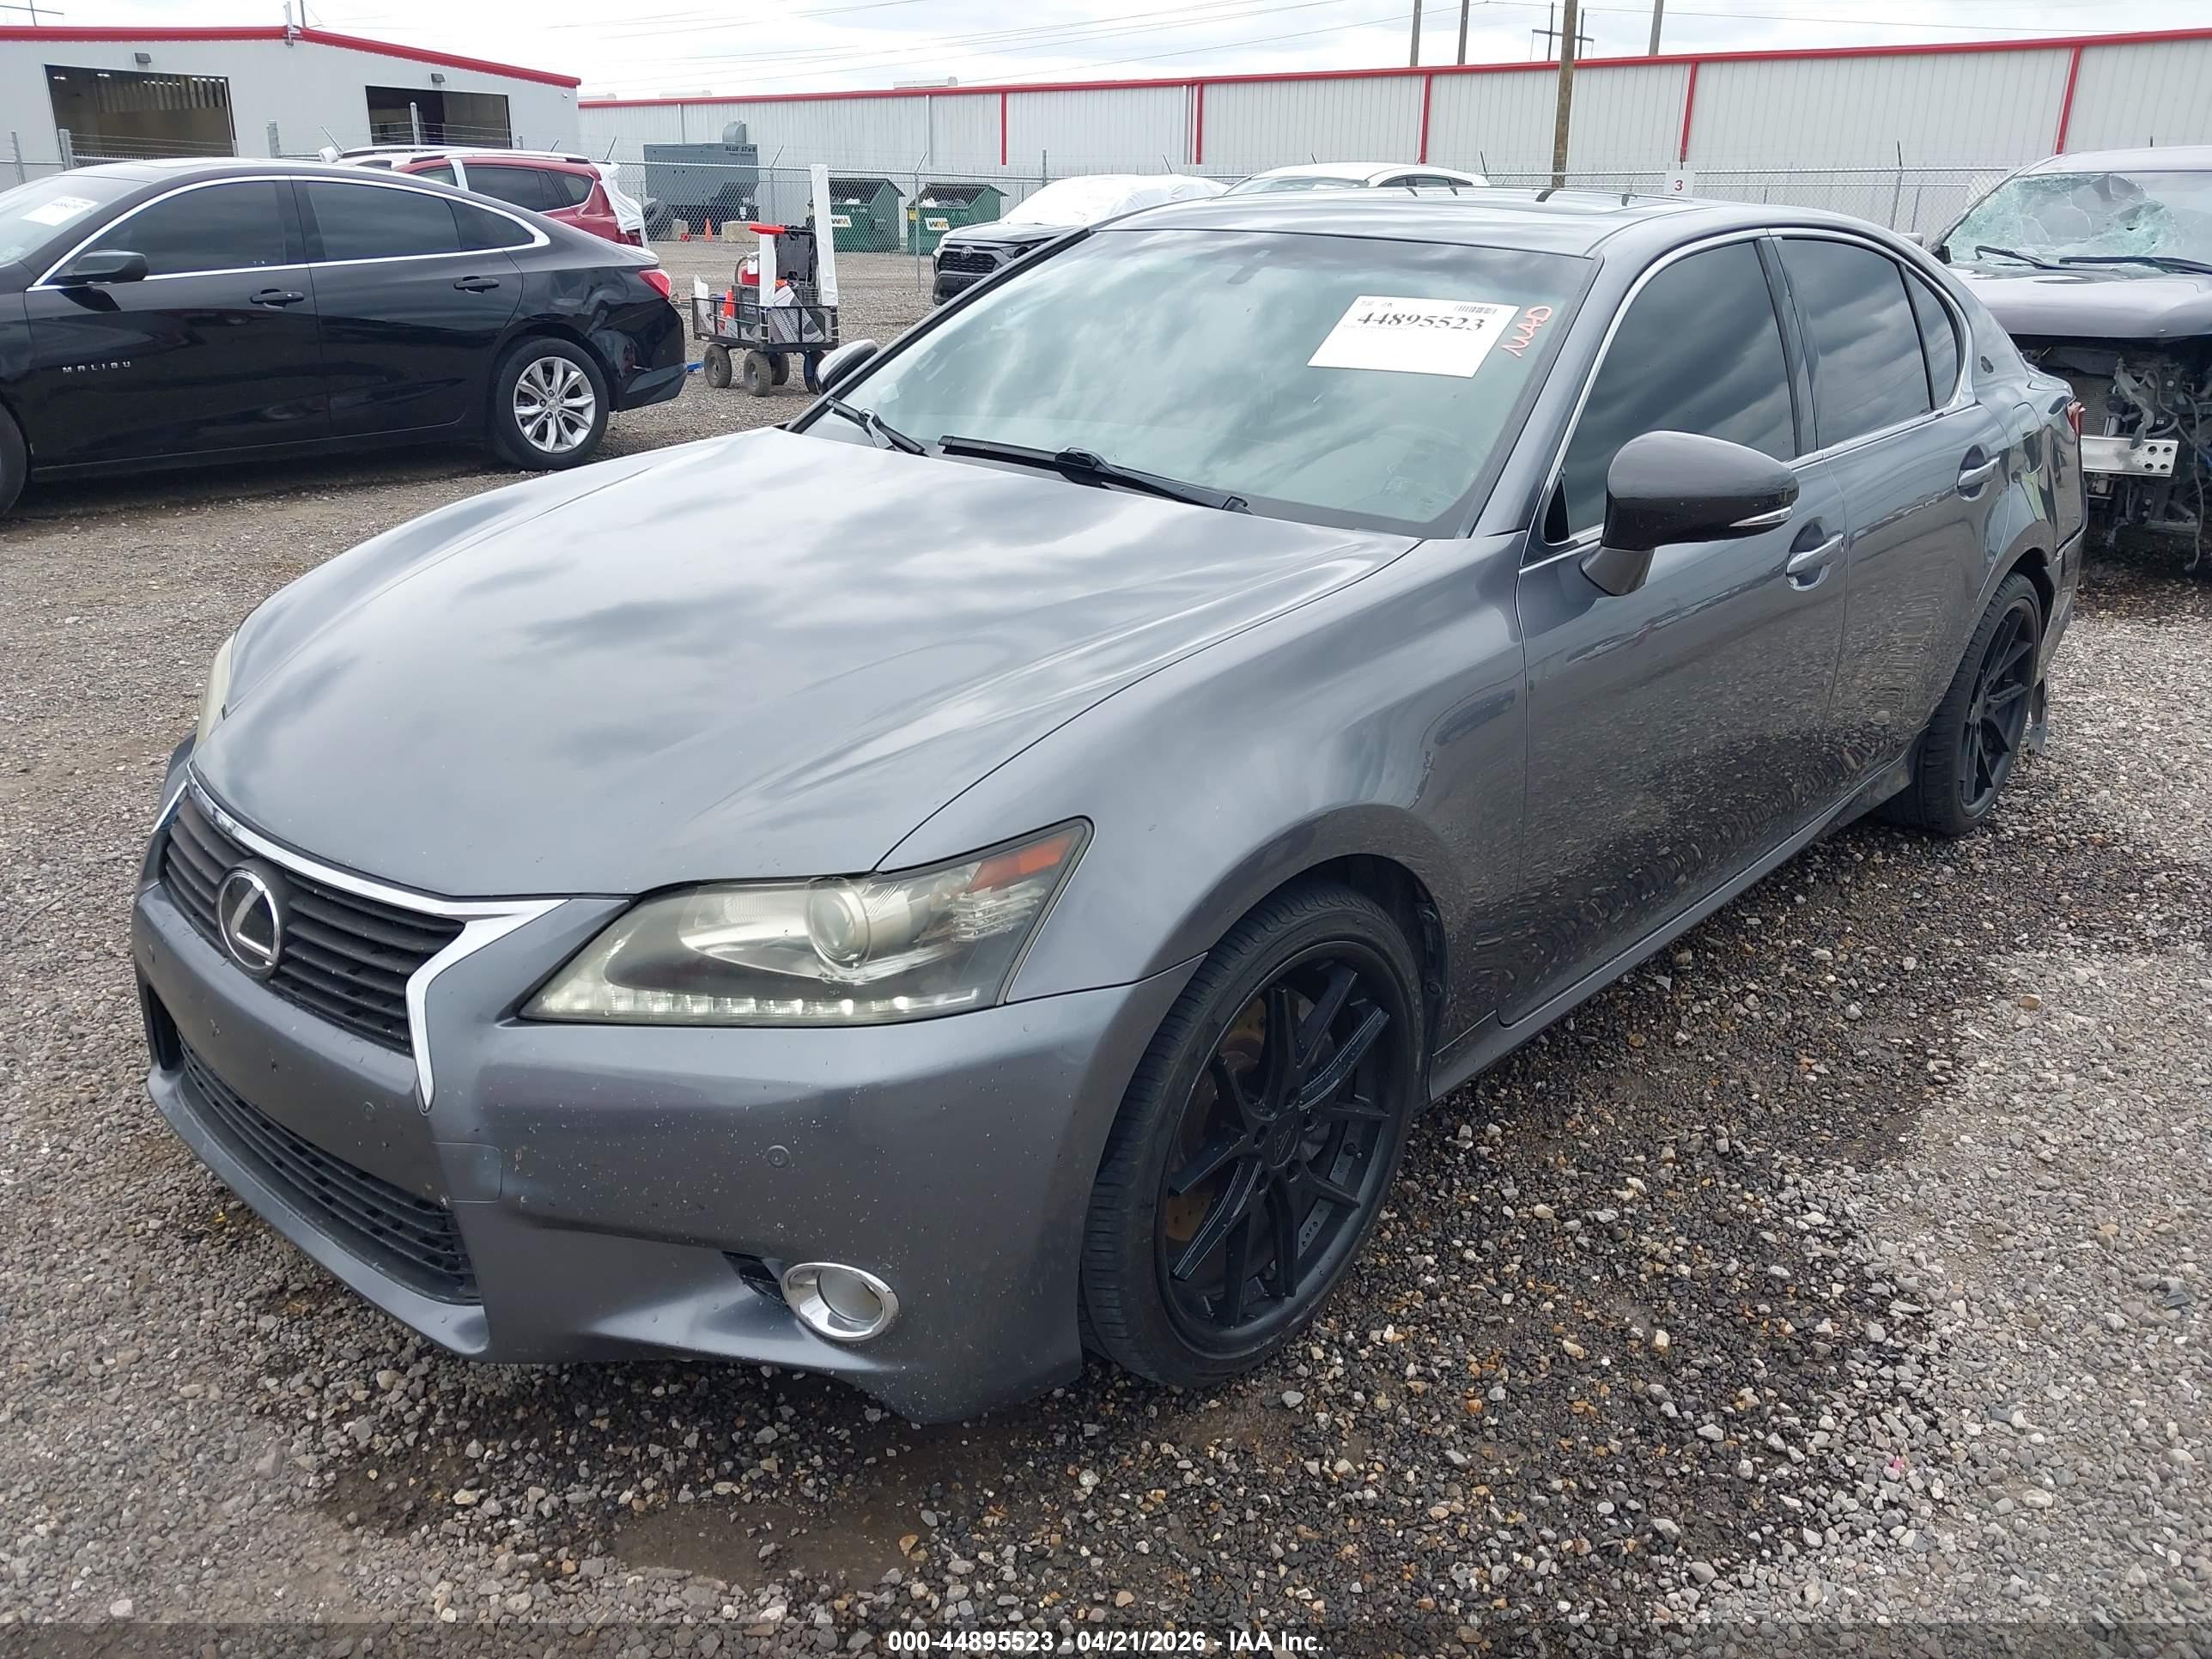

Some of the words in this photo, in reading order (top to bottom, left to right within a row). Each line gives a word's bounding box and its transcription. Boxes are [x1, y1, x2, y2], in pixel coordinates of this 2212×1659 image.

[1674, 179, 1683, 191] 3
[1357, 312, 1486, 331] 44895523
[62, 361, 131, 374] MALIBU
